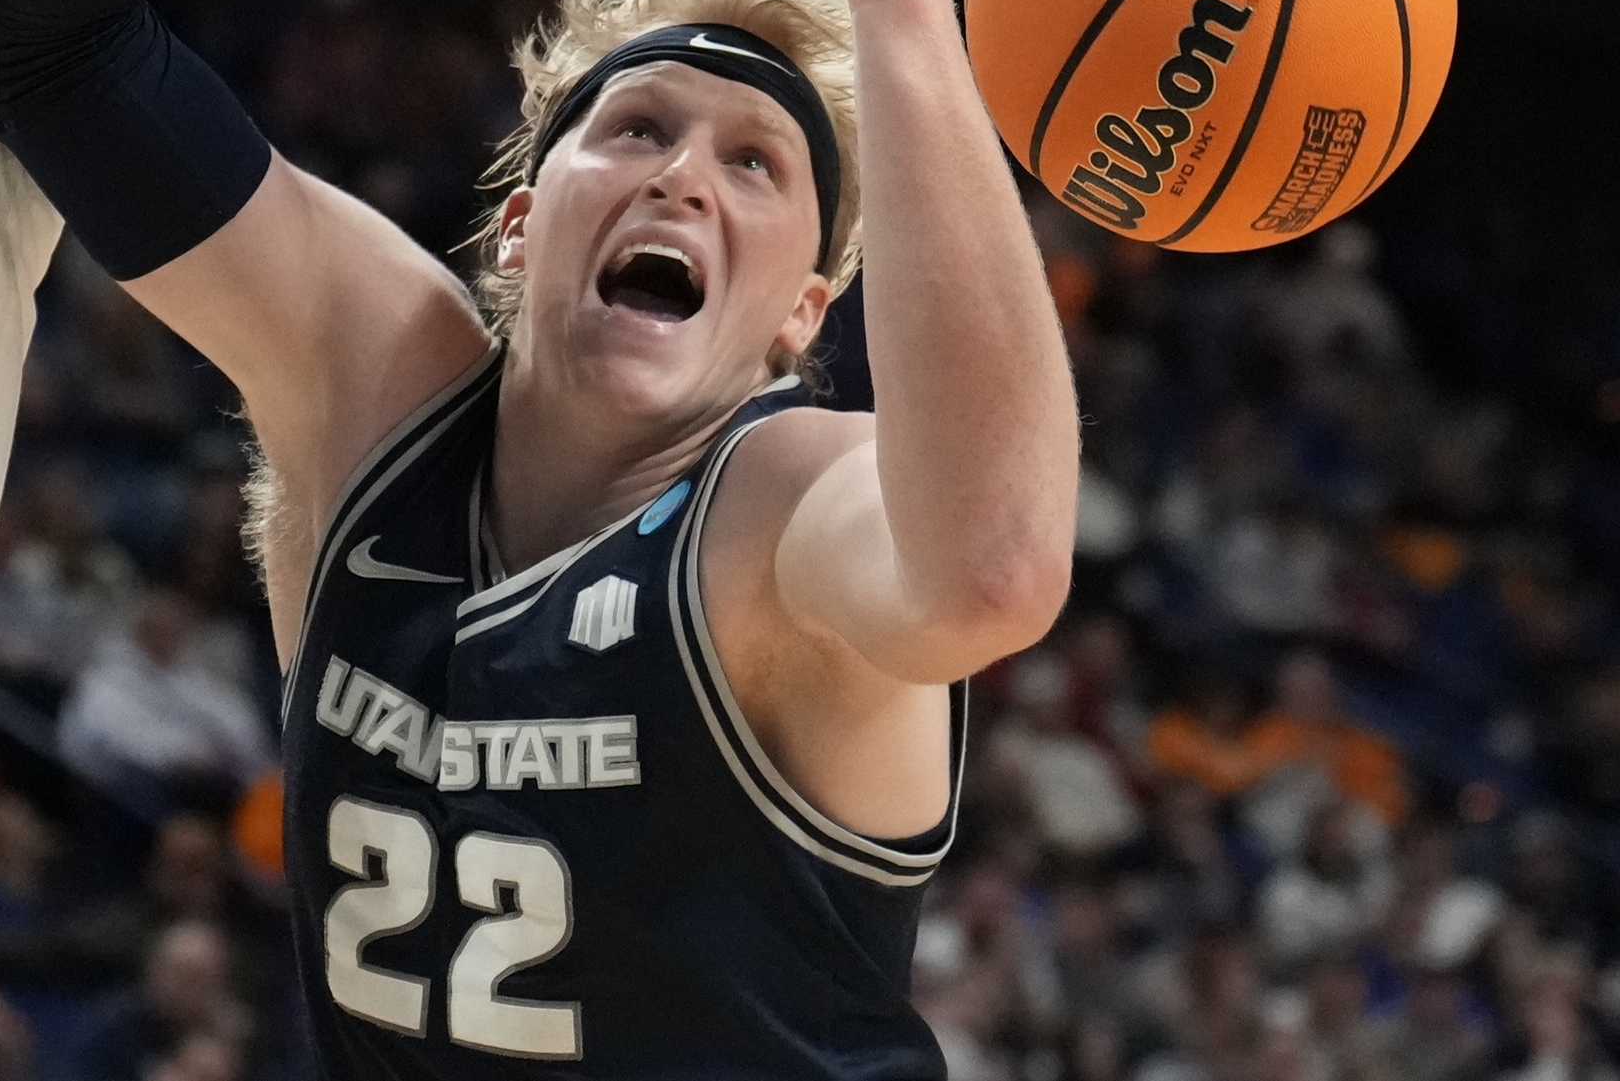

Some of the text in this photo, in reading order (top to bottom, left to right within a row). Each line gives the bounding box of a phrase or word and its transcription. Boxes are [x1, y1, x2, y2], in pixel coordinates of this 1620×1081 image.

[1169, 120, 1219, 197] EVO NXT
[1267, 149, 1324, 218] MARCH
[1297, 109, 1360, 211] MADNESS
[436, 714, 642, 792] STATE
[323, 793, 584, 1063] 22
